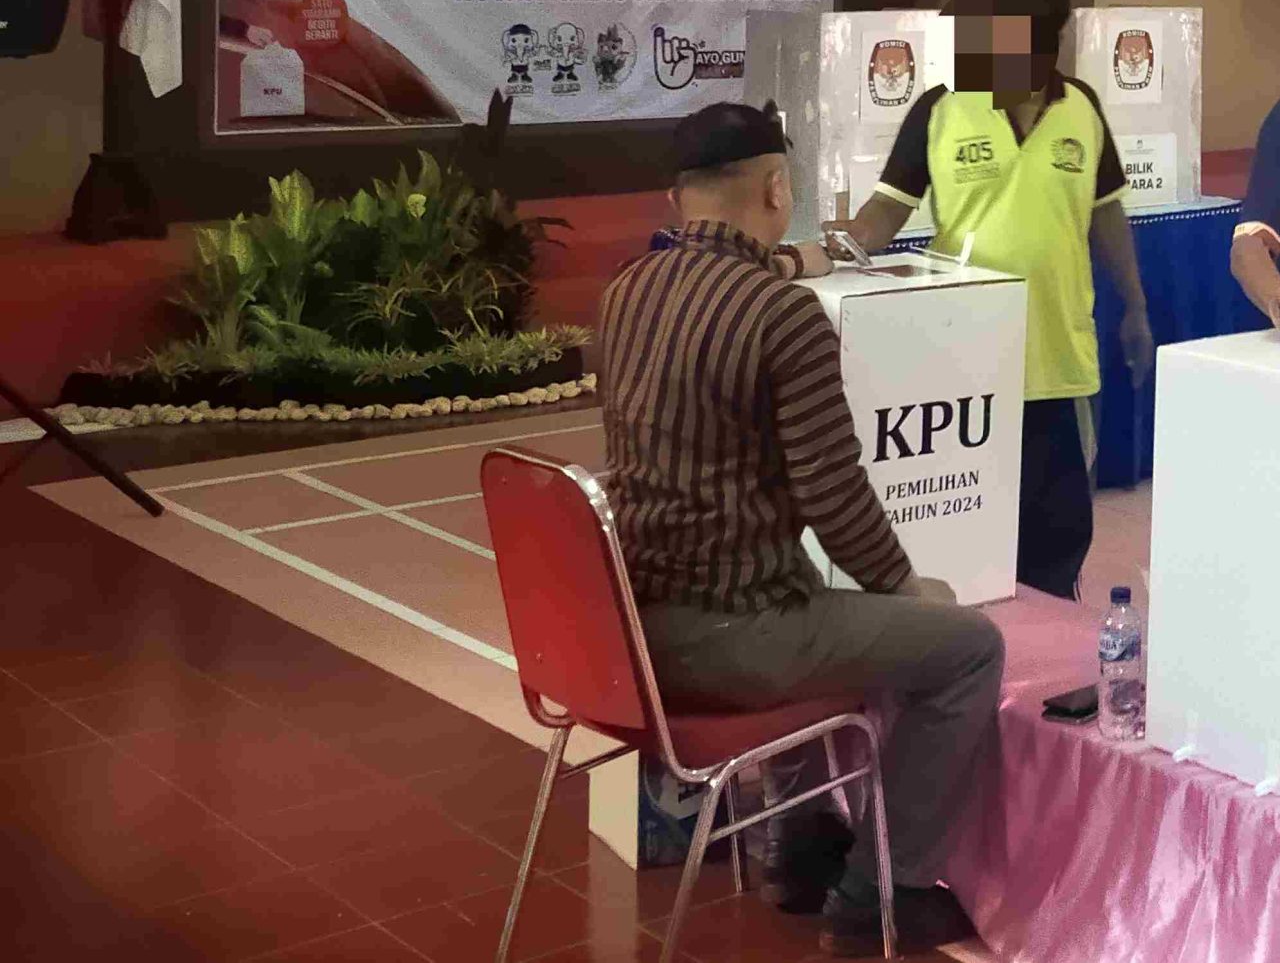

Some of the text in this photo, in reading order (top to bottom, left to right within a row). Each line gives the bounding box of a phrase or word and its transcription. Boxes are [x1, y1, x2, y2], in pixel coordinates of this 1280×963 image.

[696, 52, 720, 64] AYO
[956, 141, 993, 163] 405
[1125, 162, 1154, 175] BILIK
[1127, 177, 1163, 190] ARA 2
[872, 393, 995, 463] KPU
[885, 469, 980, 501] PEMILIHAN
[942, 494, 983, 516] 2024
